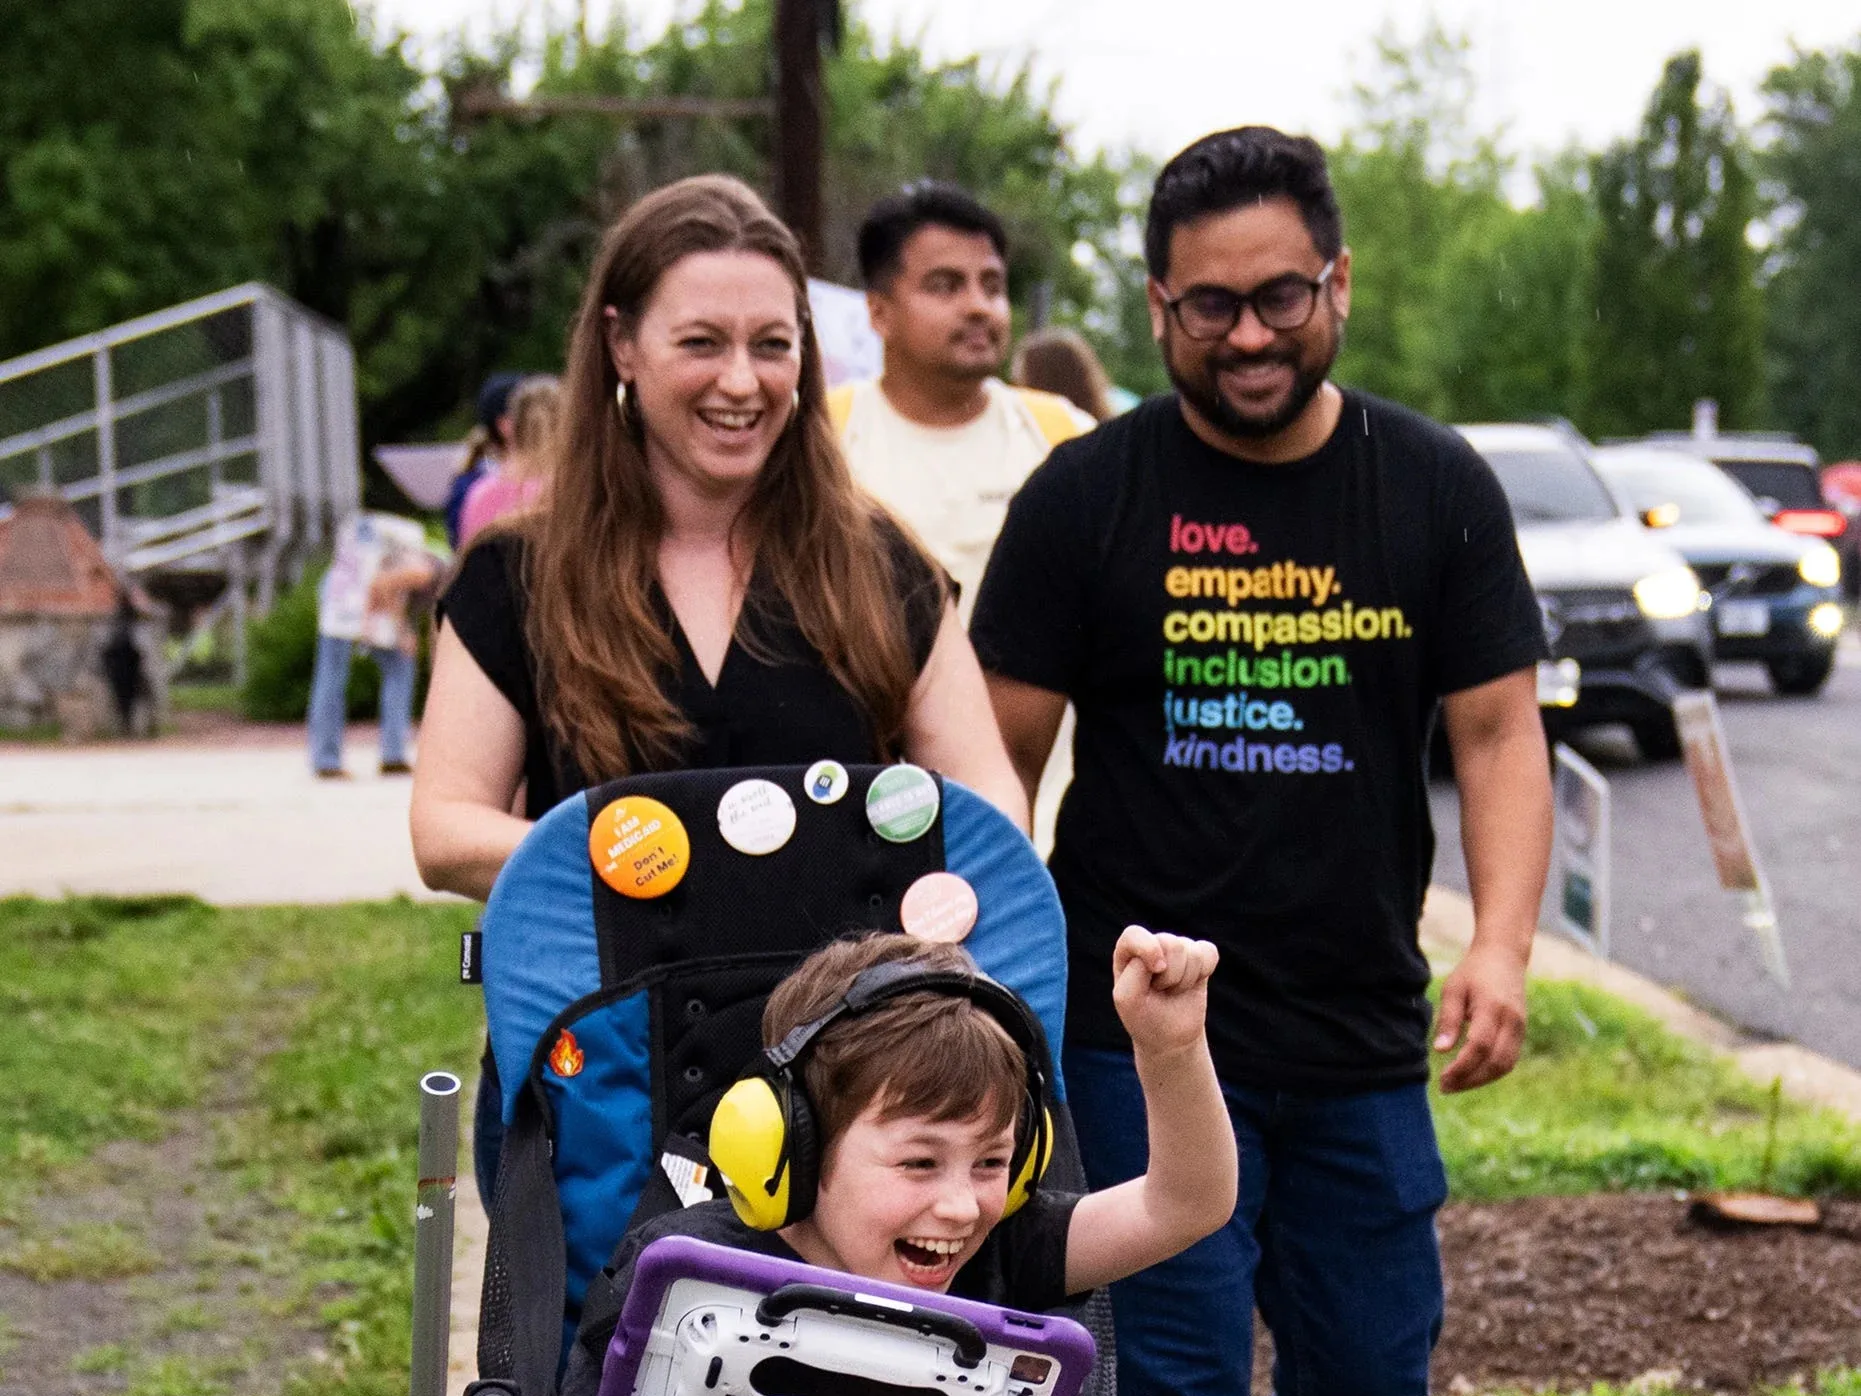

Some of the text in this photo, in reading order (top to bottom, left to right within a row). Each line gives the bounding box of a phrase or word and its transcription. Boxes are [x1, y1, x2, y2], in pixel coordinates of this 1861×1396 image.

[1169, 514, 1259, 554] love.
[1165, 559, 1342, 607] empathy.
[1163, 600, 1413, 652] compassion.
[1163, 731, 1355, 774] kindness.
